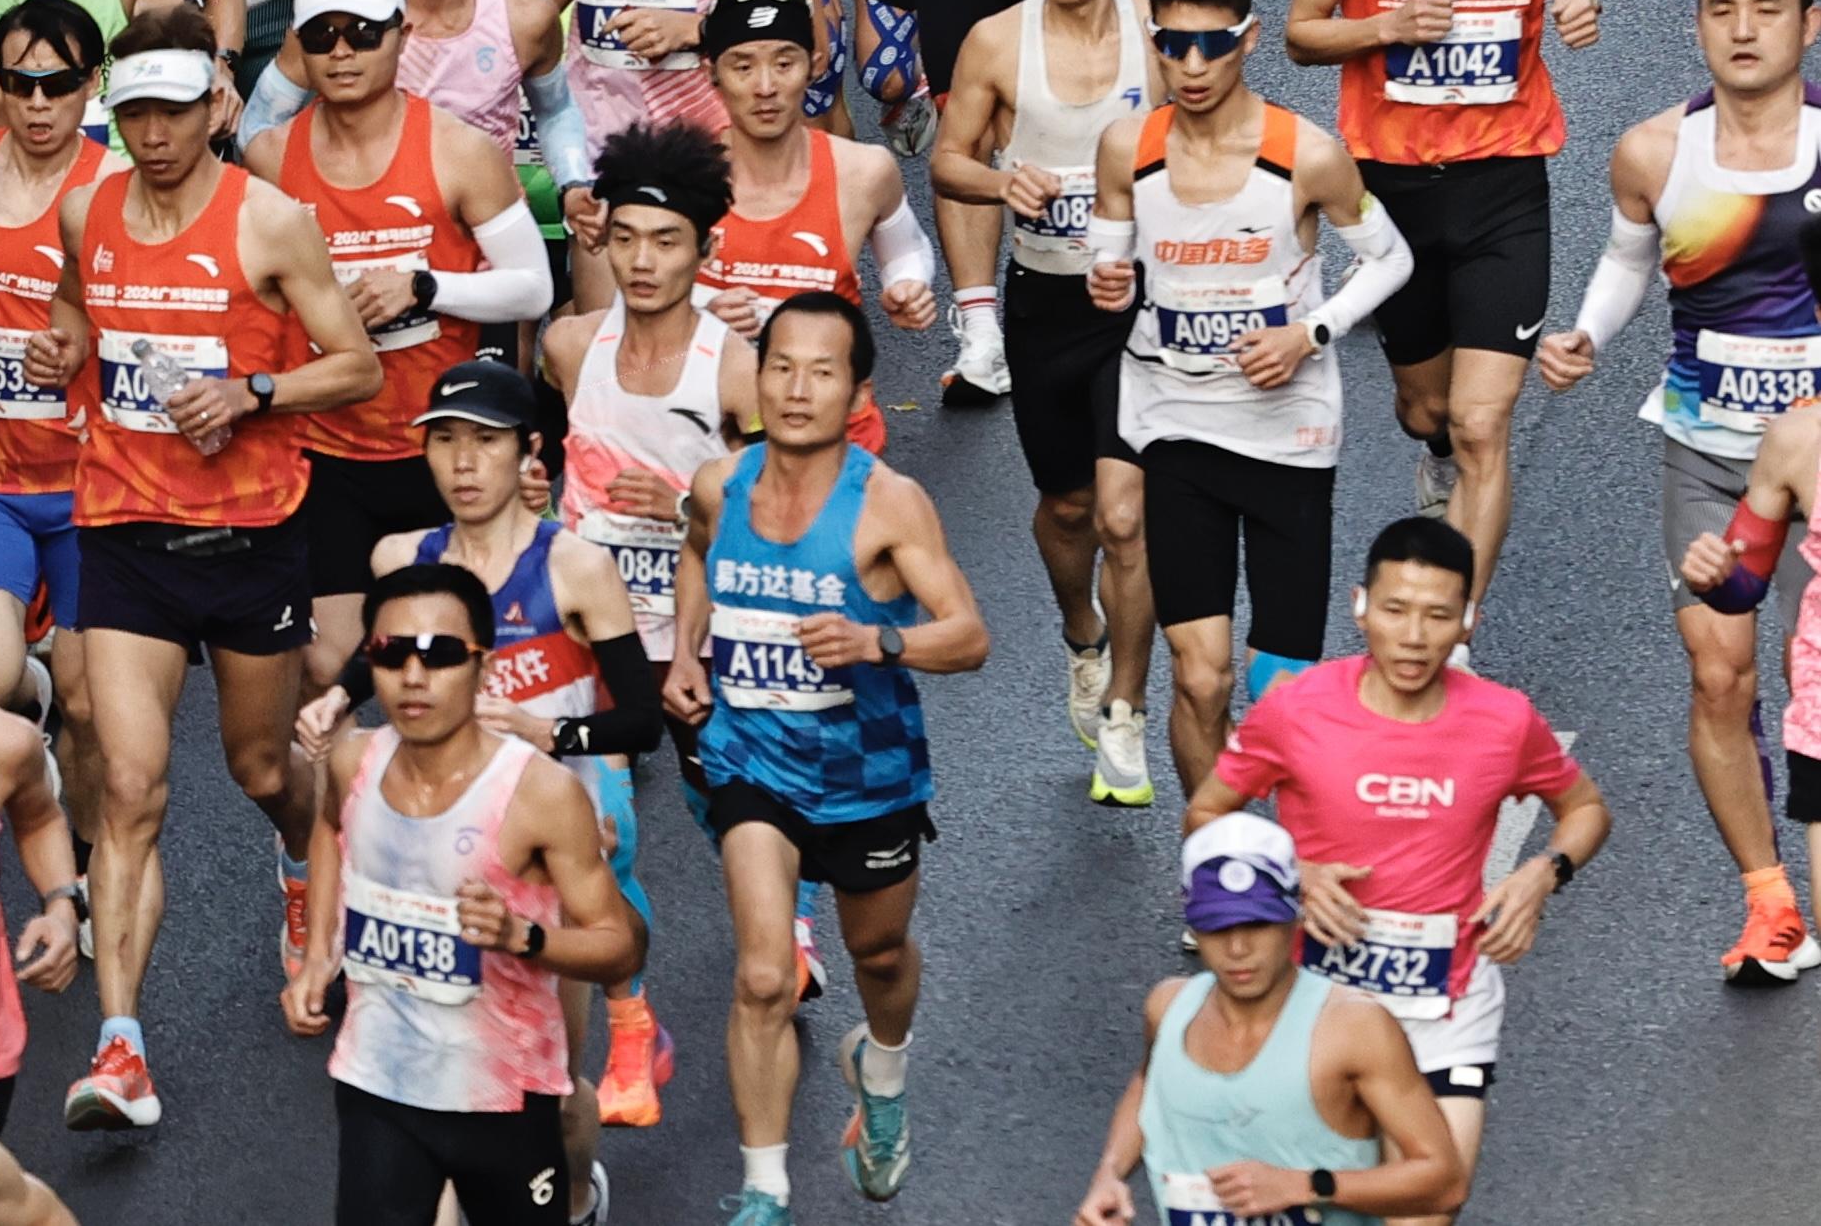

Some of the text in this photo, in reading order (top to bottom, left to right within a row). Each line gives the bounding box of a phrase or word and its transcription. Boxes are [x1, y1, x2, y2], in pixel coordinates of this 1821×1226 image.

[1405, 44, 1503, 78] A1042
[1716, 365, 1816, 405] A0338
[720, 559, 852, 607] 易方达基金
[1355, 773, 1454, 807] CBN
[359, 919, 456, 973] A0138
[1321, 941, 1430, 986] A2732
